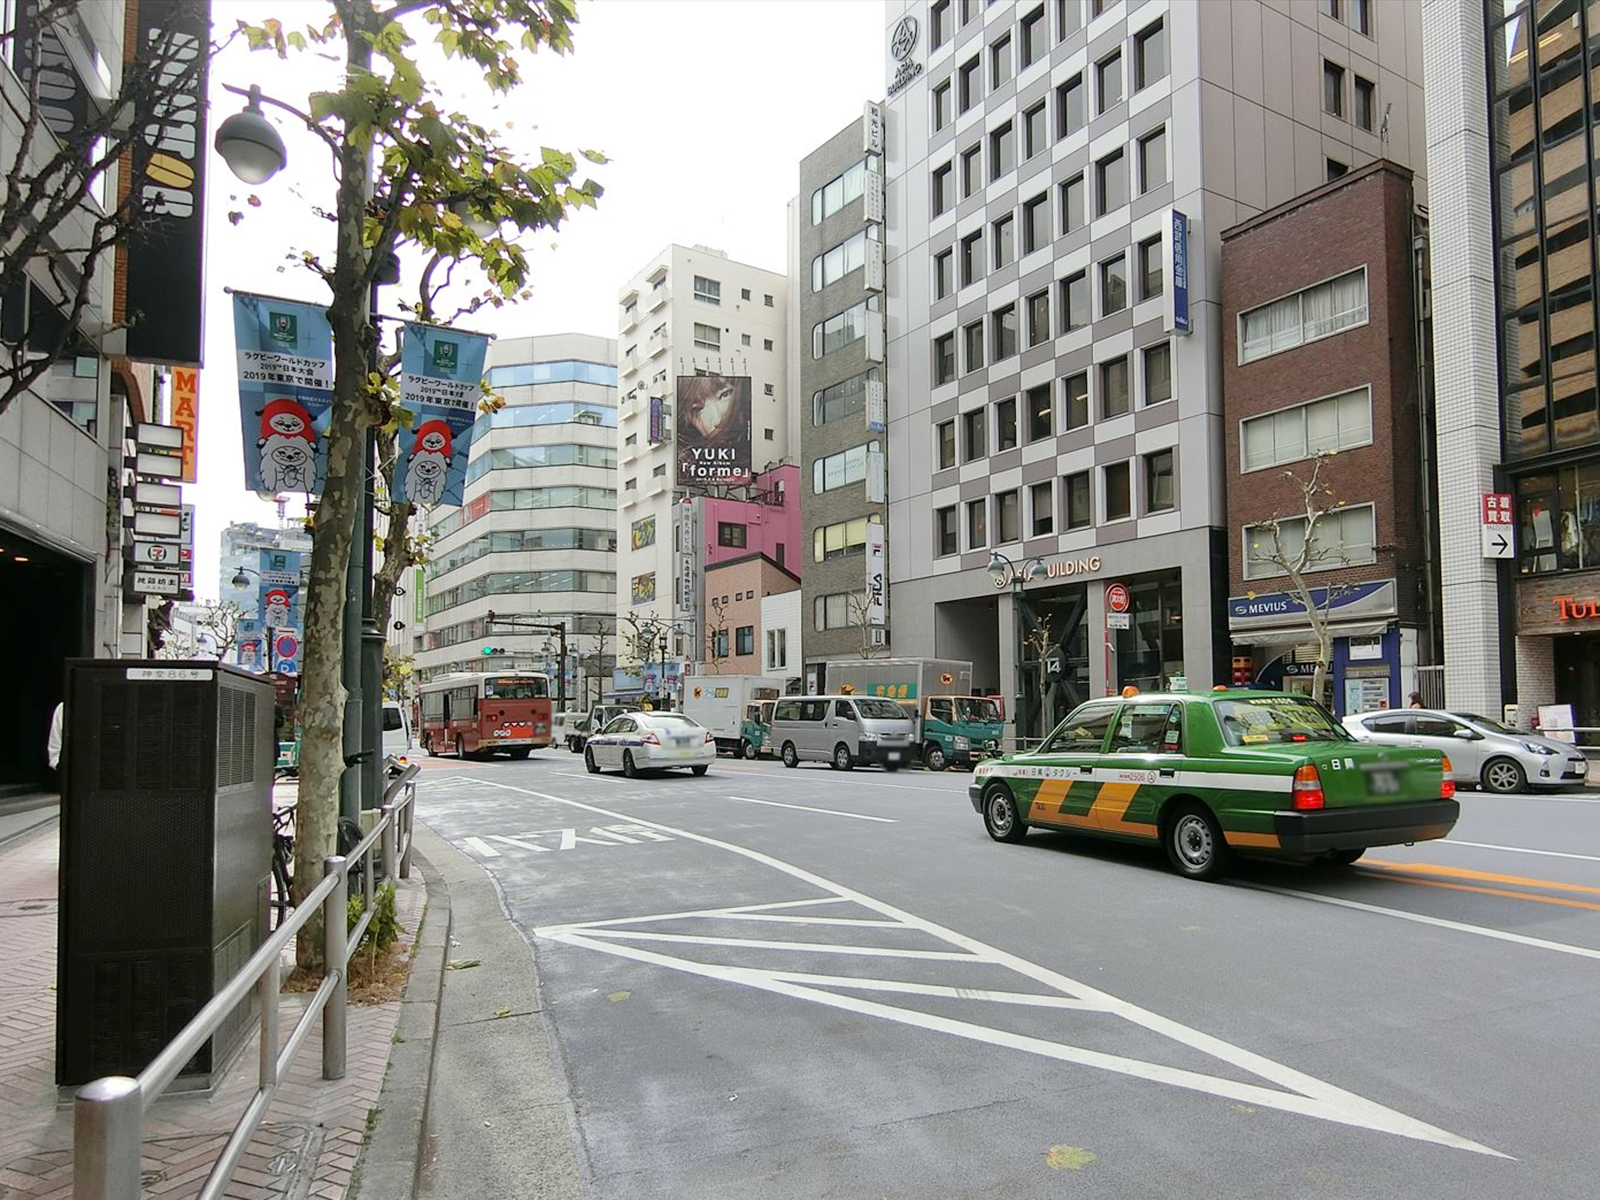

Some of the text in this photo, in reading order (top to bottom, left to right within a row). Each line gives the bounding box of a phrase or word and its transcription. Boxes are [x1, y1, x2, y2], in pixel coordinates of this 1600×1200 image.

[895, 57, 914, 79] ASIA
[887, 63, 922, 97] BUILDING
[1174, 218, 1183, 289] 西武信用金庫
[244, 351, 326, 369] ラグビーワールドカップ
[408, 375, 475, 392] ラグビーワールドカップ
[691, 448, 736, 460] YUKI
[1486, 495, 1510, 509] 古着
[1046, 556, 1101, 579] UILDING
[1248, 601, 1287, 614] MEVIUS
